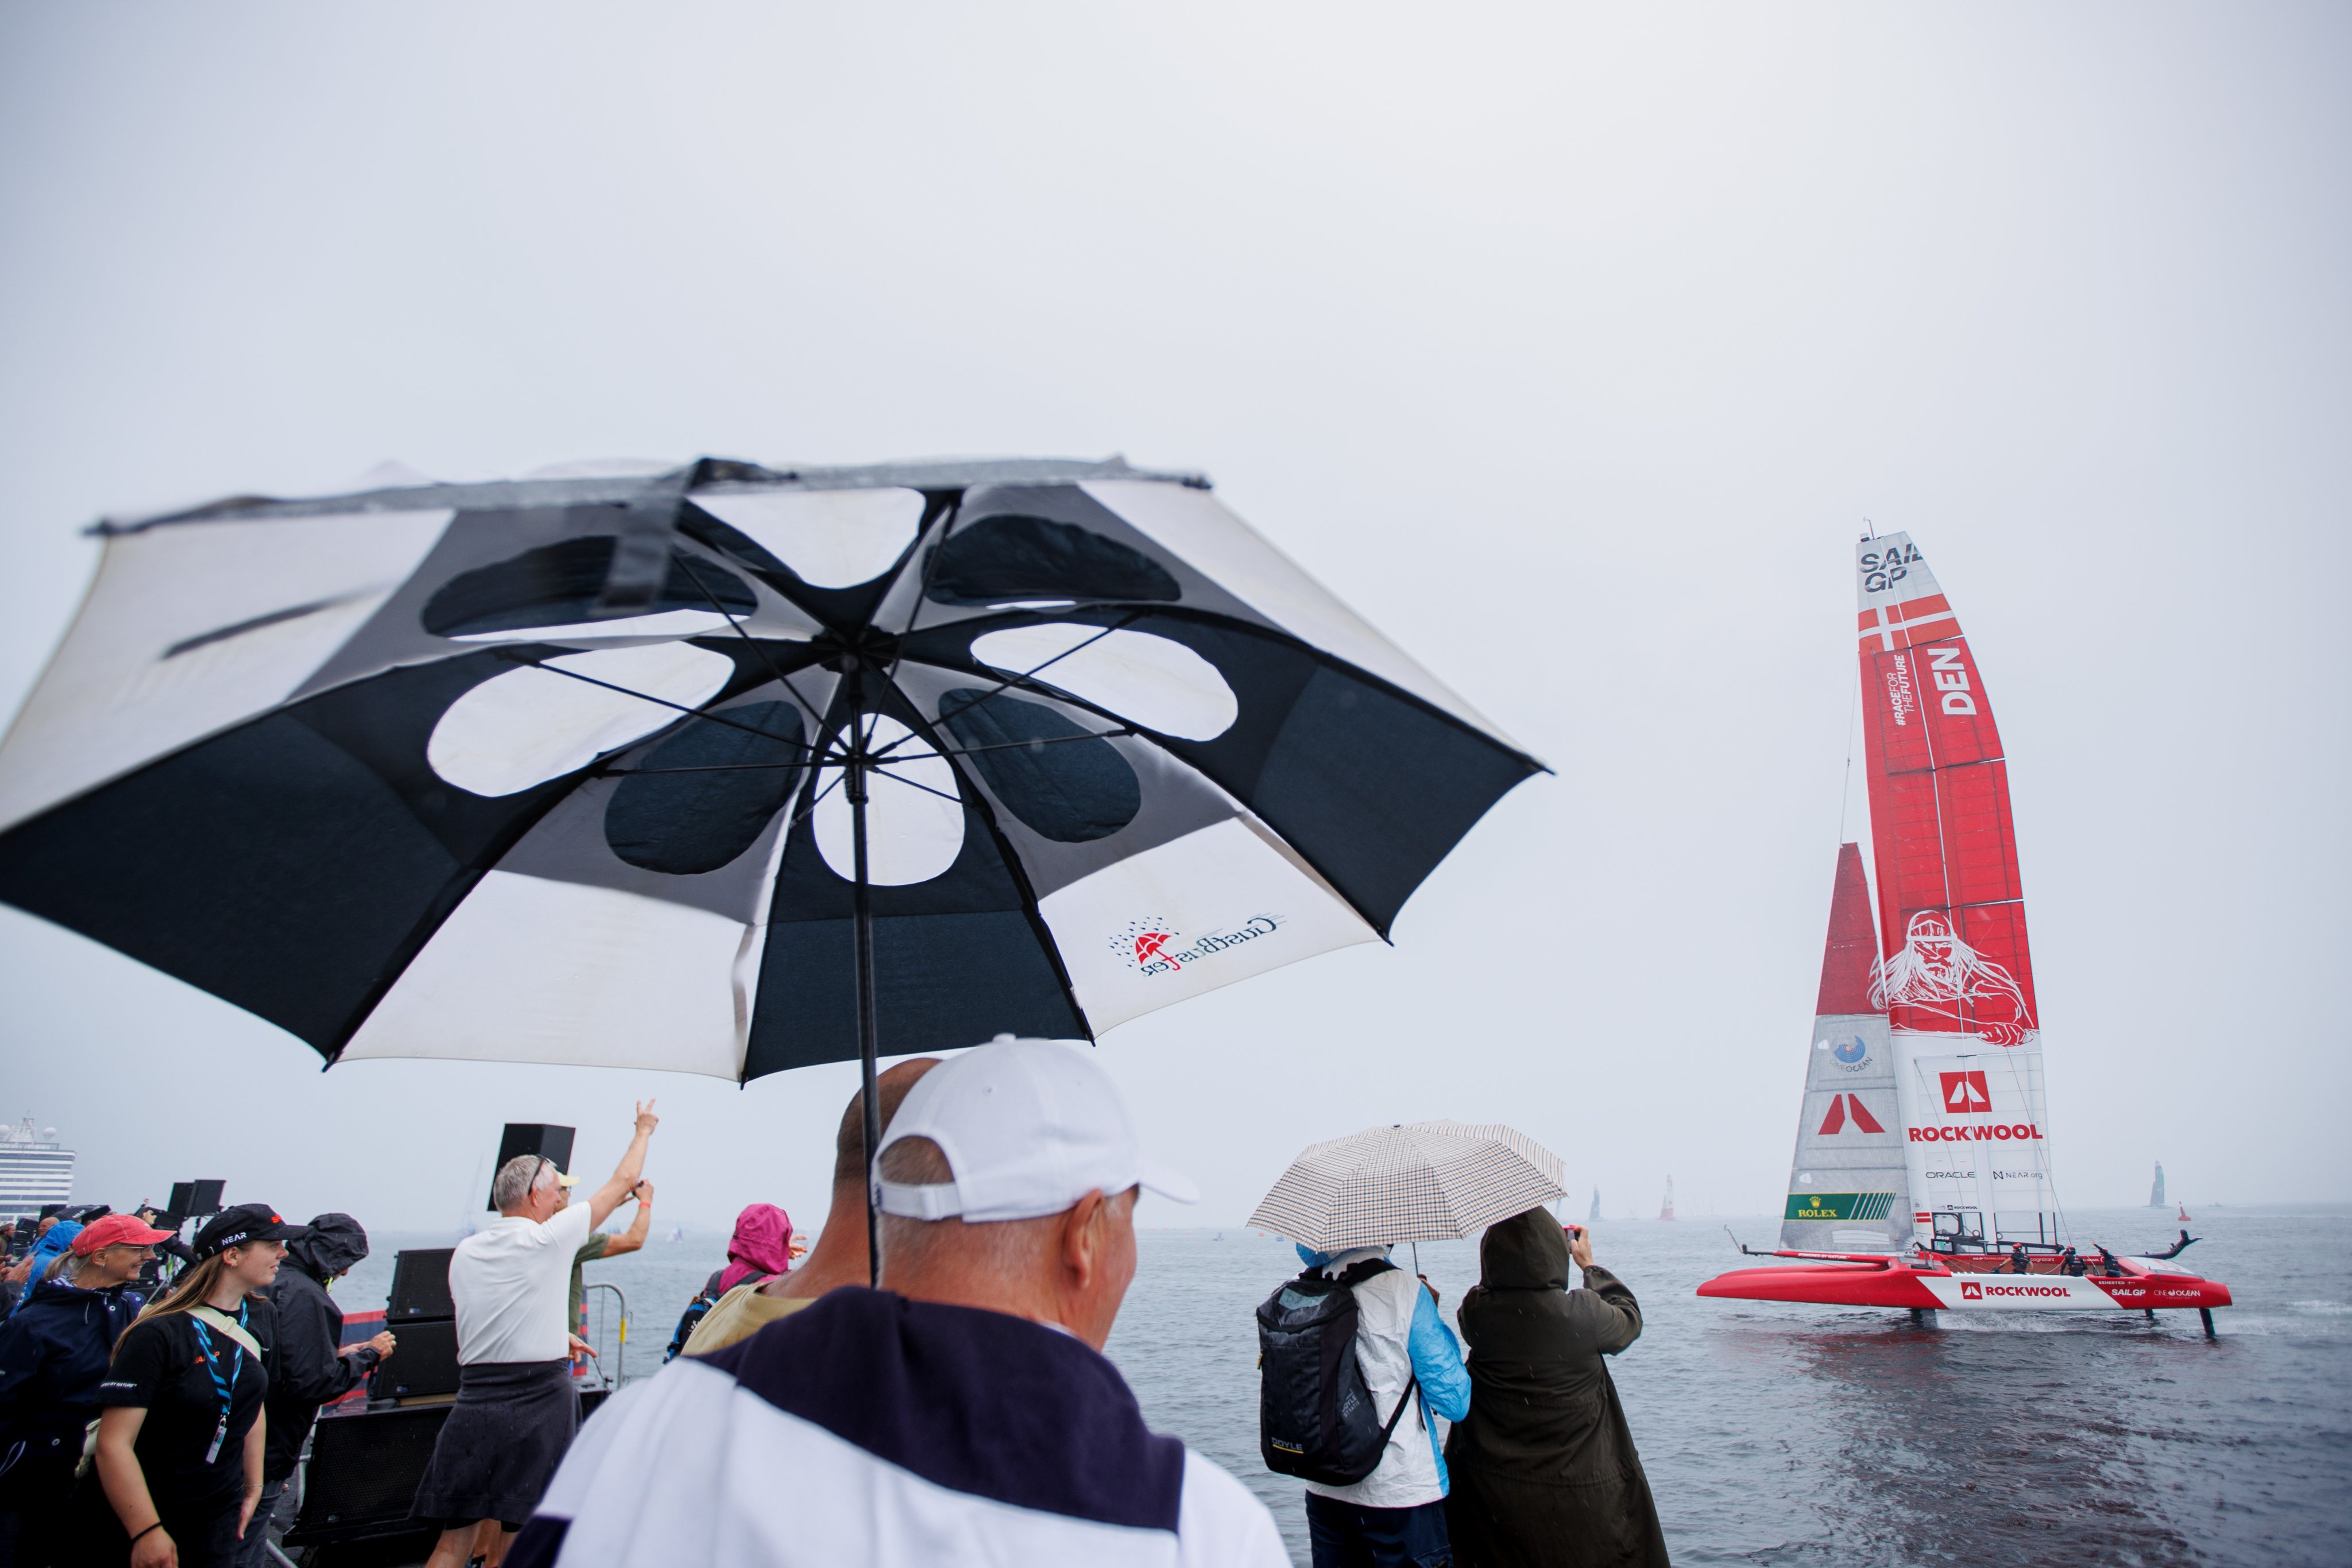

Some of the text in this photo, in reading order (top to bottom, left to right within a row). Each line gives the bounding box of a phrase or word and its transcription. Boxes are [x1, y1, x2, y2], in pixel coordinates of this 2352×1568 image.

[1860, 543, 1924, 573] SAIL
[1864, 566, 1908, 593] GP
[1894, 655, 1914, 713] THEFUTURE
[1927, 648, 1977, 715] DEN
[1887, 672, 1906, 726] #RACEFOR
[1846, 1056, 1873, 1072] OCEAN
[1908, 1124, 2044, 1142] ROCKWOOL
[1798, 1209, 1838, 1218] ROLEX
[222, 1232, 247, 1245] NEAR
[1985, 1286, 2071, 1297] ROCKWOOL
[1271, 1437, 1303, 1451] DOYLE
